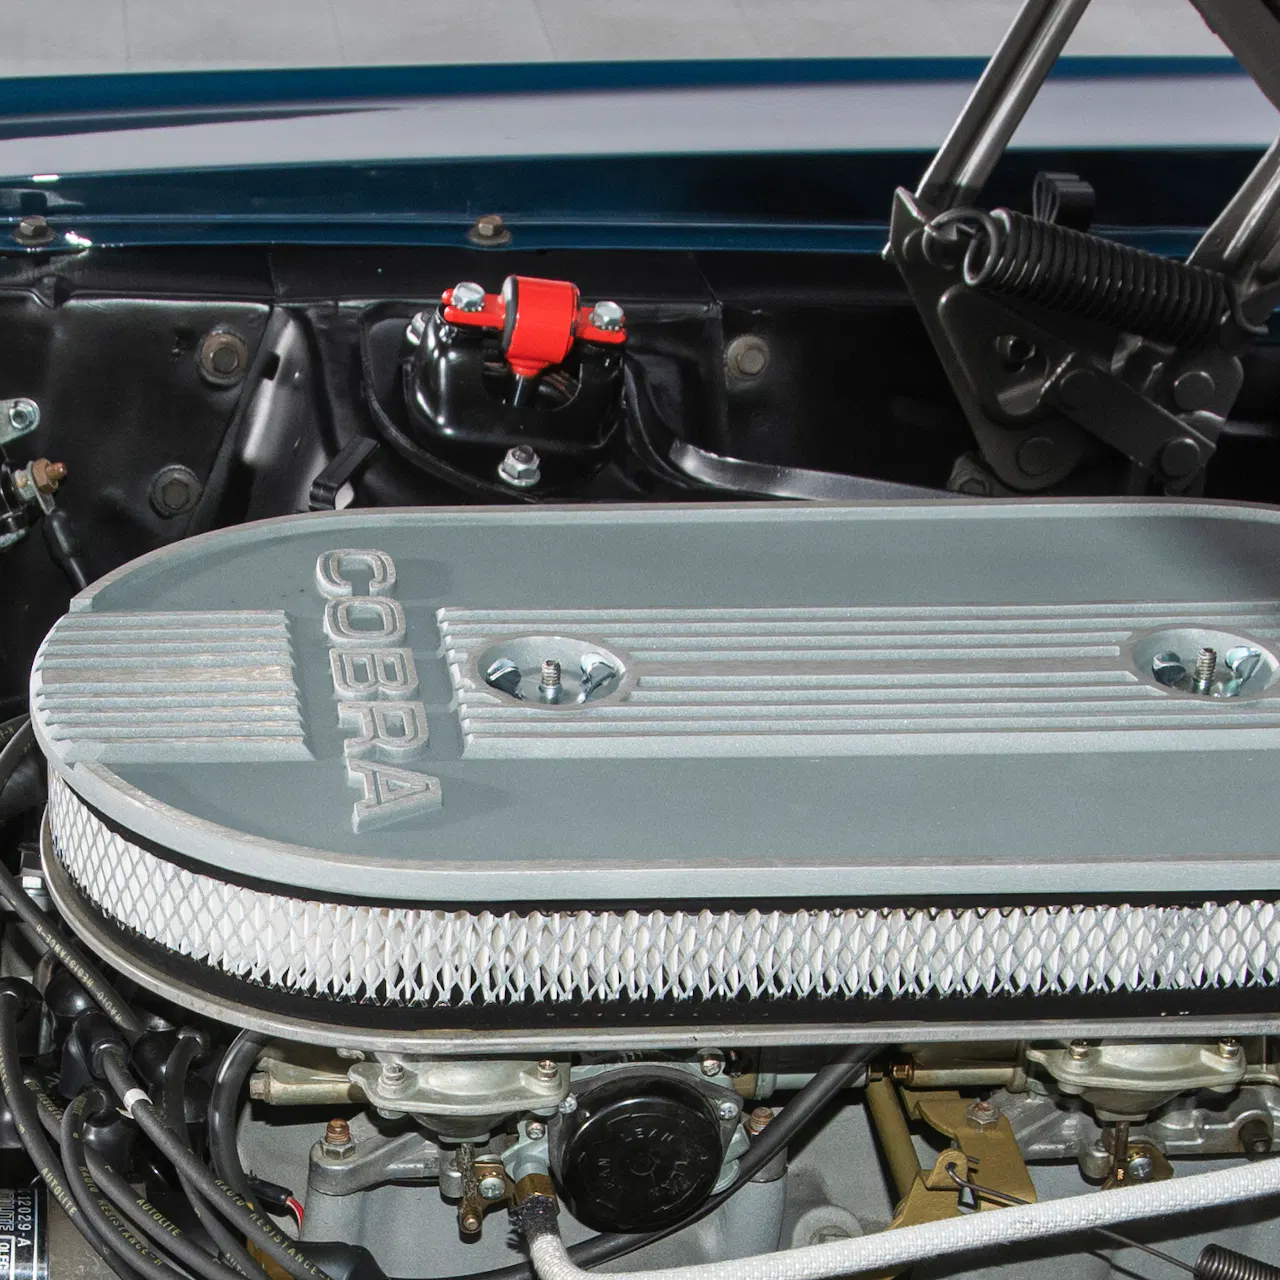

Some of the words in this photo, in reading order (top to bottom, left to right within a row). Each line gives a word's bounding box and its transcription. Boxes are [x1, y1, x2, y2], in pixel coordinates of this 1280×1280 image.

[317, 549, 443, 832] COBRA
[96, 990, 122, 1023] RADIO
[40, 1166, 78, 1217] AUTOLITE
[215, 1178, 247, 1207] RADIO
[136, 1199, 183, 1237] AUTOLITE
